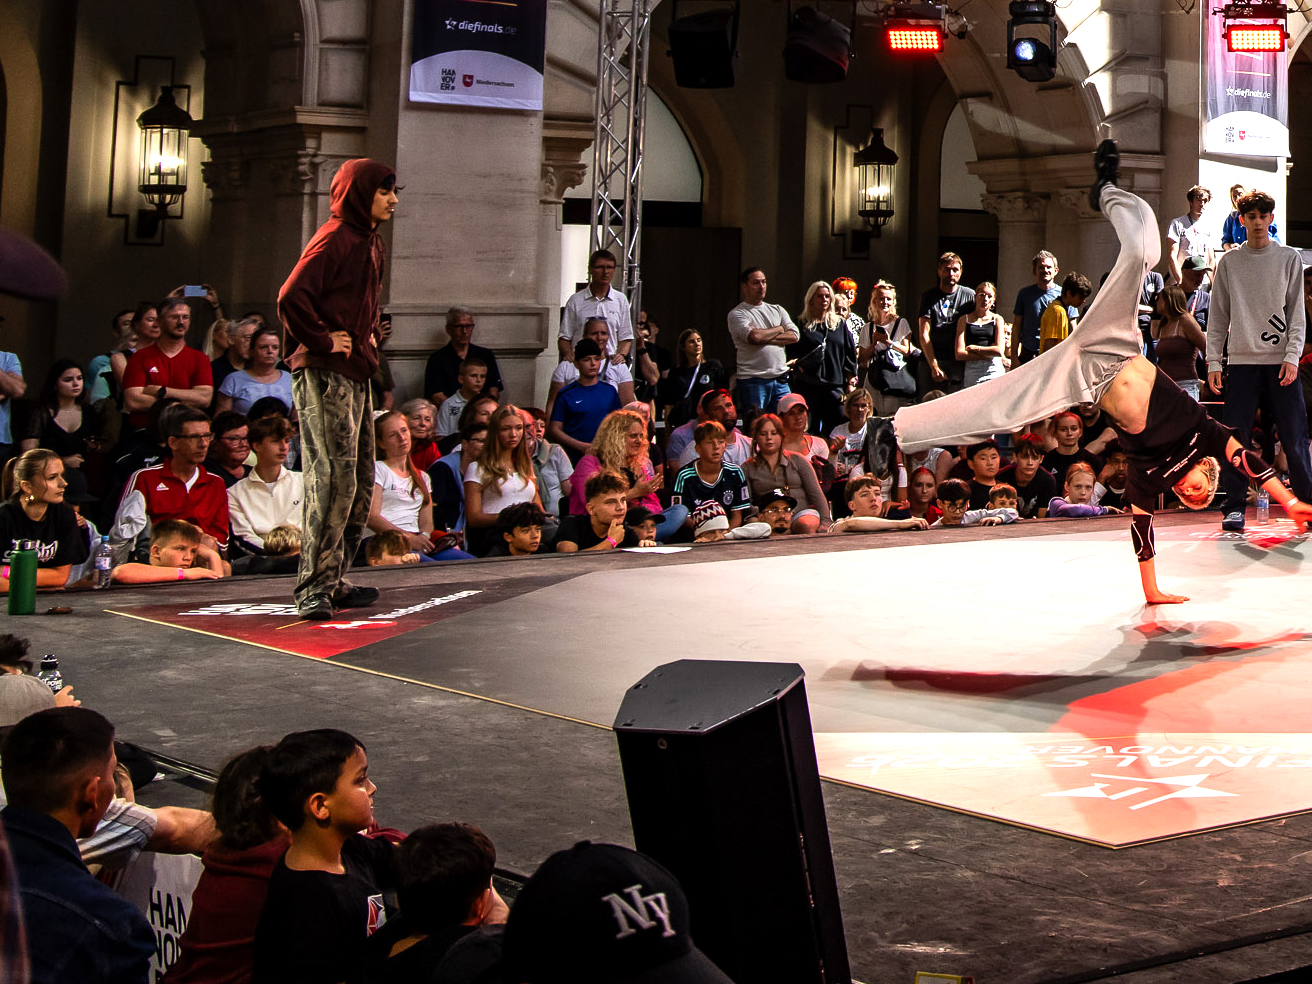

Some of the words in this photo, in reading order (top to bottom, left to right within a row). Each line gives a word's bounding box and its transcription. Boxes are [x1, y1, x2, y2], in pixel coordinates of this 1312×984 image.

[458, 19, 517, 35] diefinals.de
[475, 78, 516, 88] Niedersachsen
[1020, 745, 1303, 755] HANNOVER
[843, 753, 1037, 778] 2026
[150, 887, 188, 935] HAN
[601, 884, 676, 939] NY
